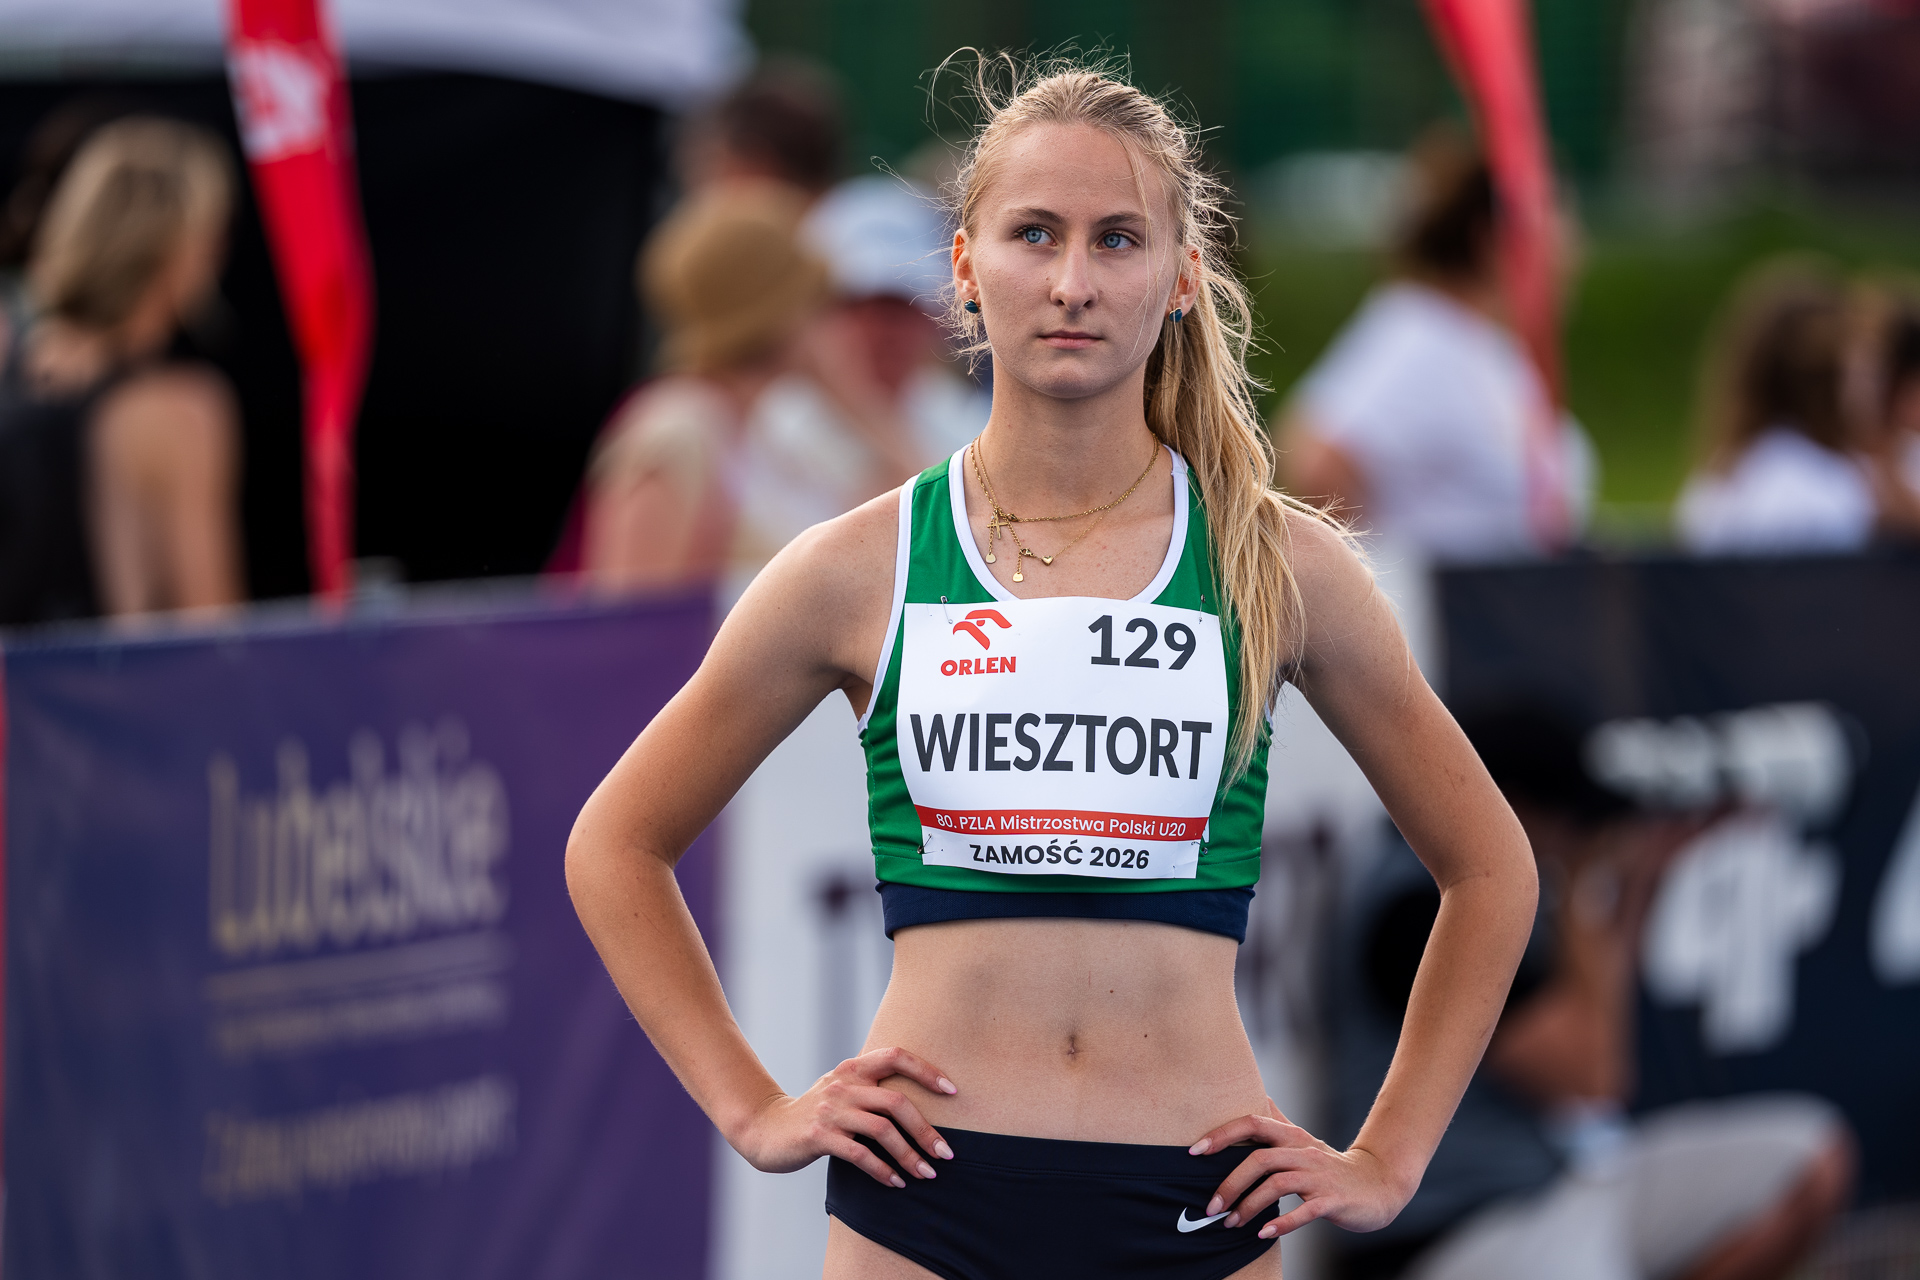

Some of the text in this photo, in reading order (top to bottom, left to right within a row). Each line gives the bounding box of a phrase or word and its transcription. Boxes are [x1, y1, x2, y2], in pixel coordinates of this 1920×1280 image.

[1088, 614, 1197, 670] 129
[940, 656, 1017, 677] ORLEN
[910, 713, 1212, 780] WIESZTORT
[935, 813, 1186, 837] 80. PZLA Mistrzostwa Polski U20
[969, 838, 1149, 869] ZAMOŚĆ 2026
